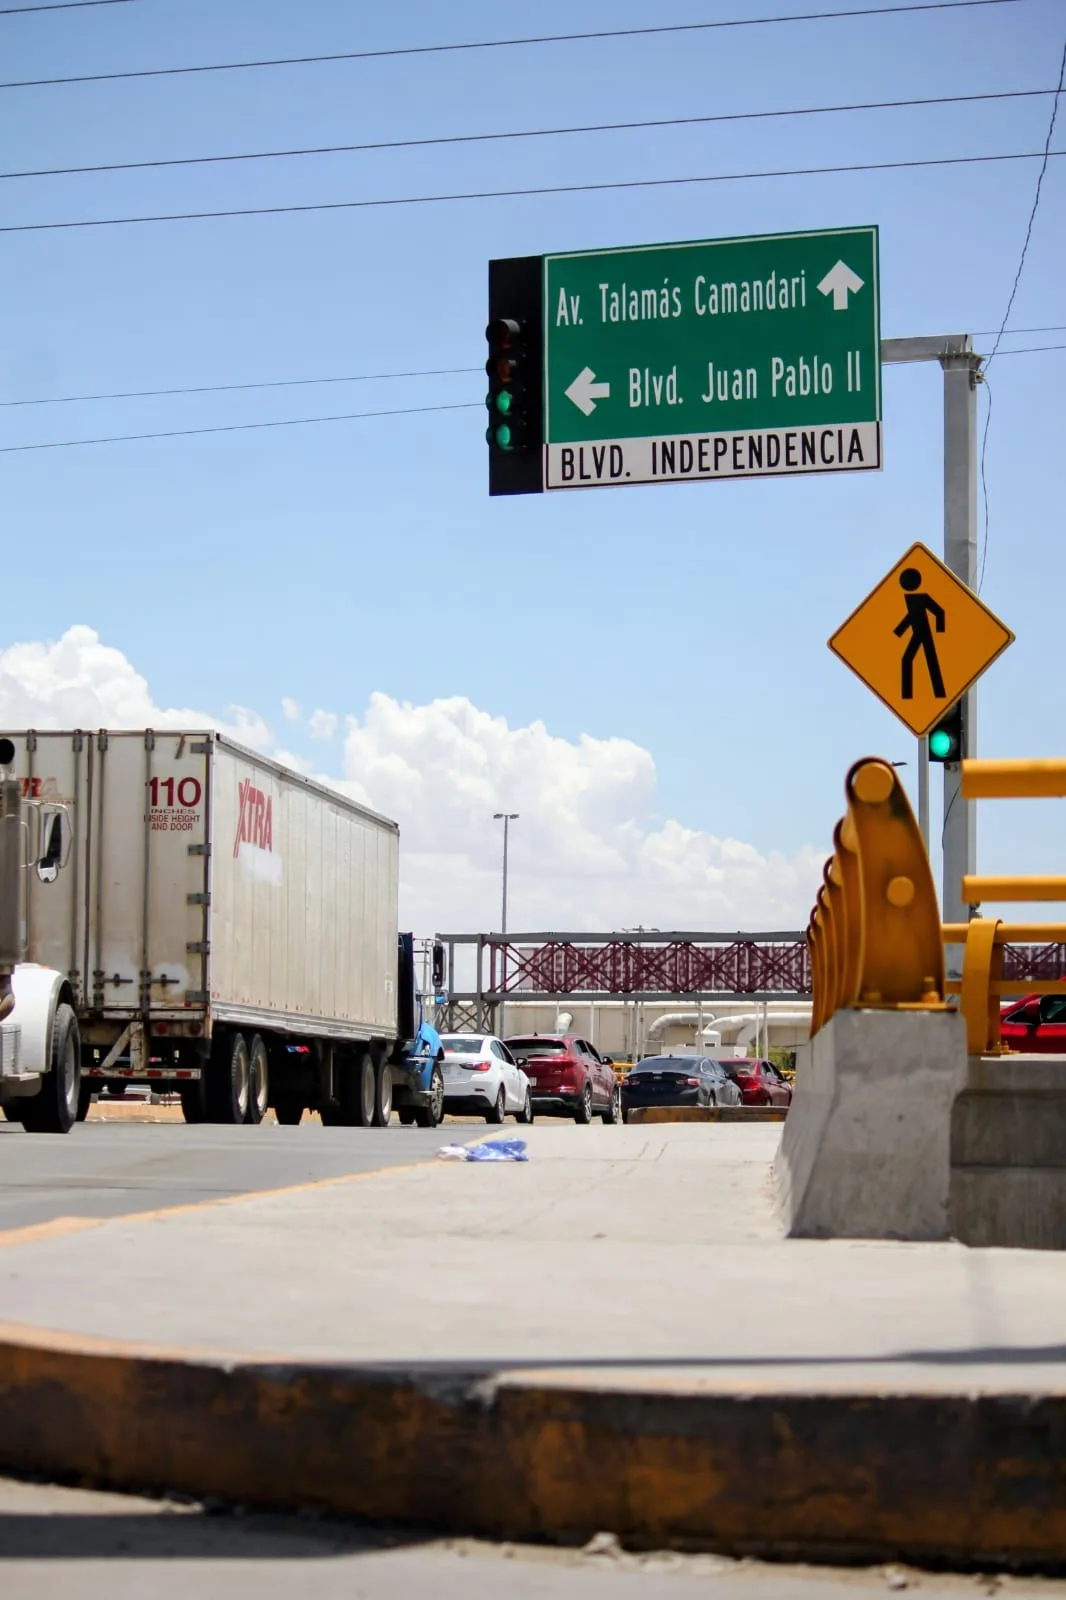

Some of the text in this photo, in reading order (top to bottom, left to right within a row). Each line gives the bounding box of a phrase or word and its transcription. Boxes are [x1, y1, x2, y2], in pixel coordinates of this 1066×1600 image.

[556, 269, 806, 327] Av. Talamás Camandari
[629, 350, 861, 408] Blvd. Juan Pablo II
[561, 428, 865, 481] BLVD. INDEPENDENCIA
[145, 776, 202, 807] 110
[232, 777, 273, 859] XTRA
[151, 822, 193, 831] AND DOOR
[171, 814, 201, 823] HEIGHT
